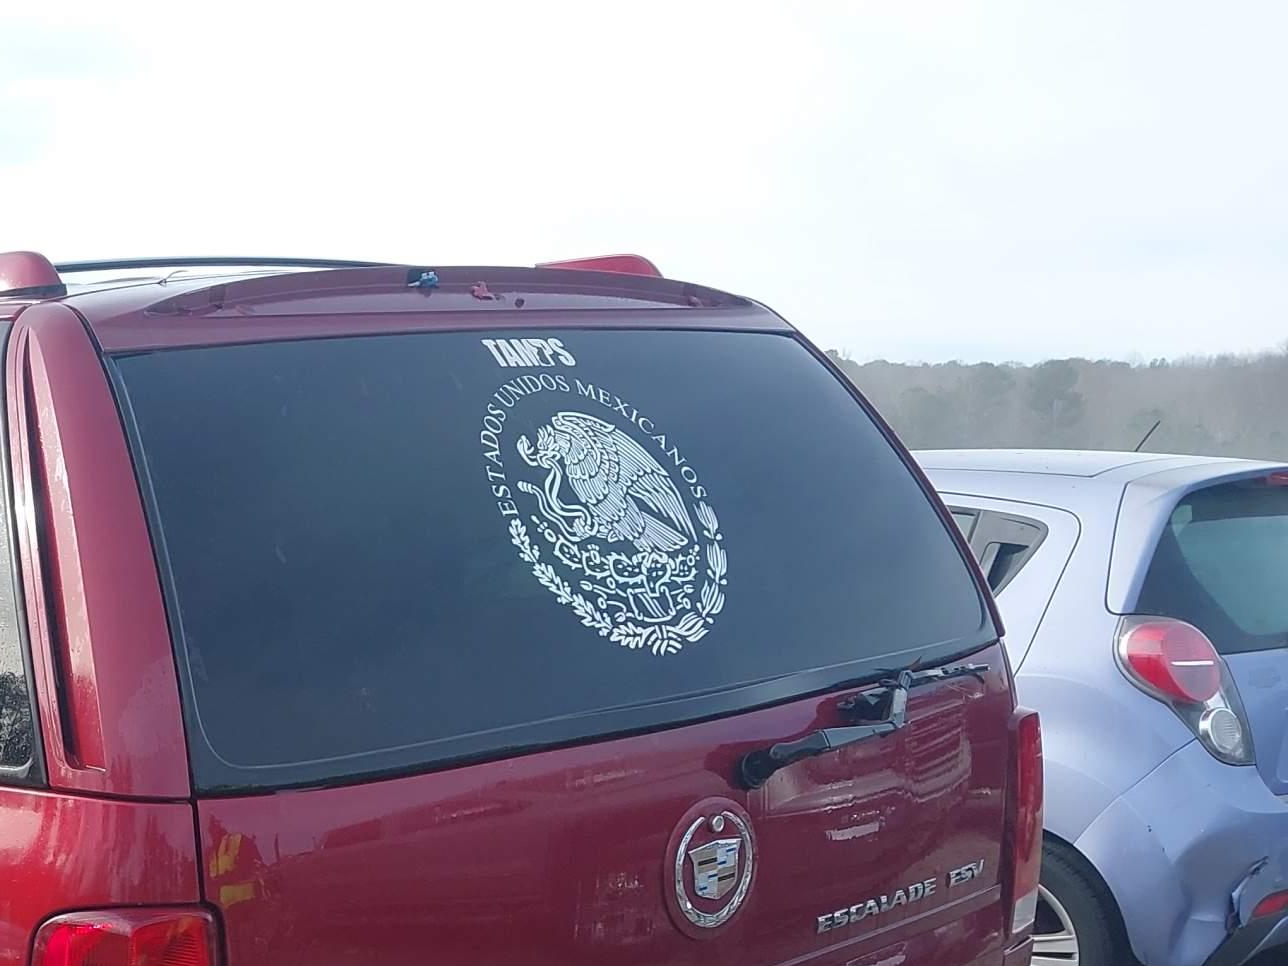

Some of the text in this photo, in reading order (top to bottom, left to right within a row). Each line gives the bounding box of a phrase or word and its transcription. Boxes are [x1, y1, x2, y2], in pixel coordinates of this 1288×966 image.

[480, 373, 707, 516] ESTADOS UNIDOS MEXICANOS
[817, 859, 985, 934] ESCALADE ESV
